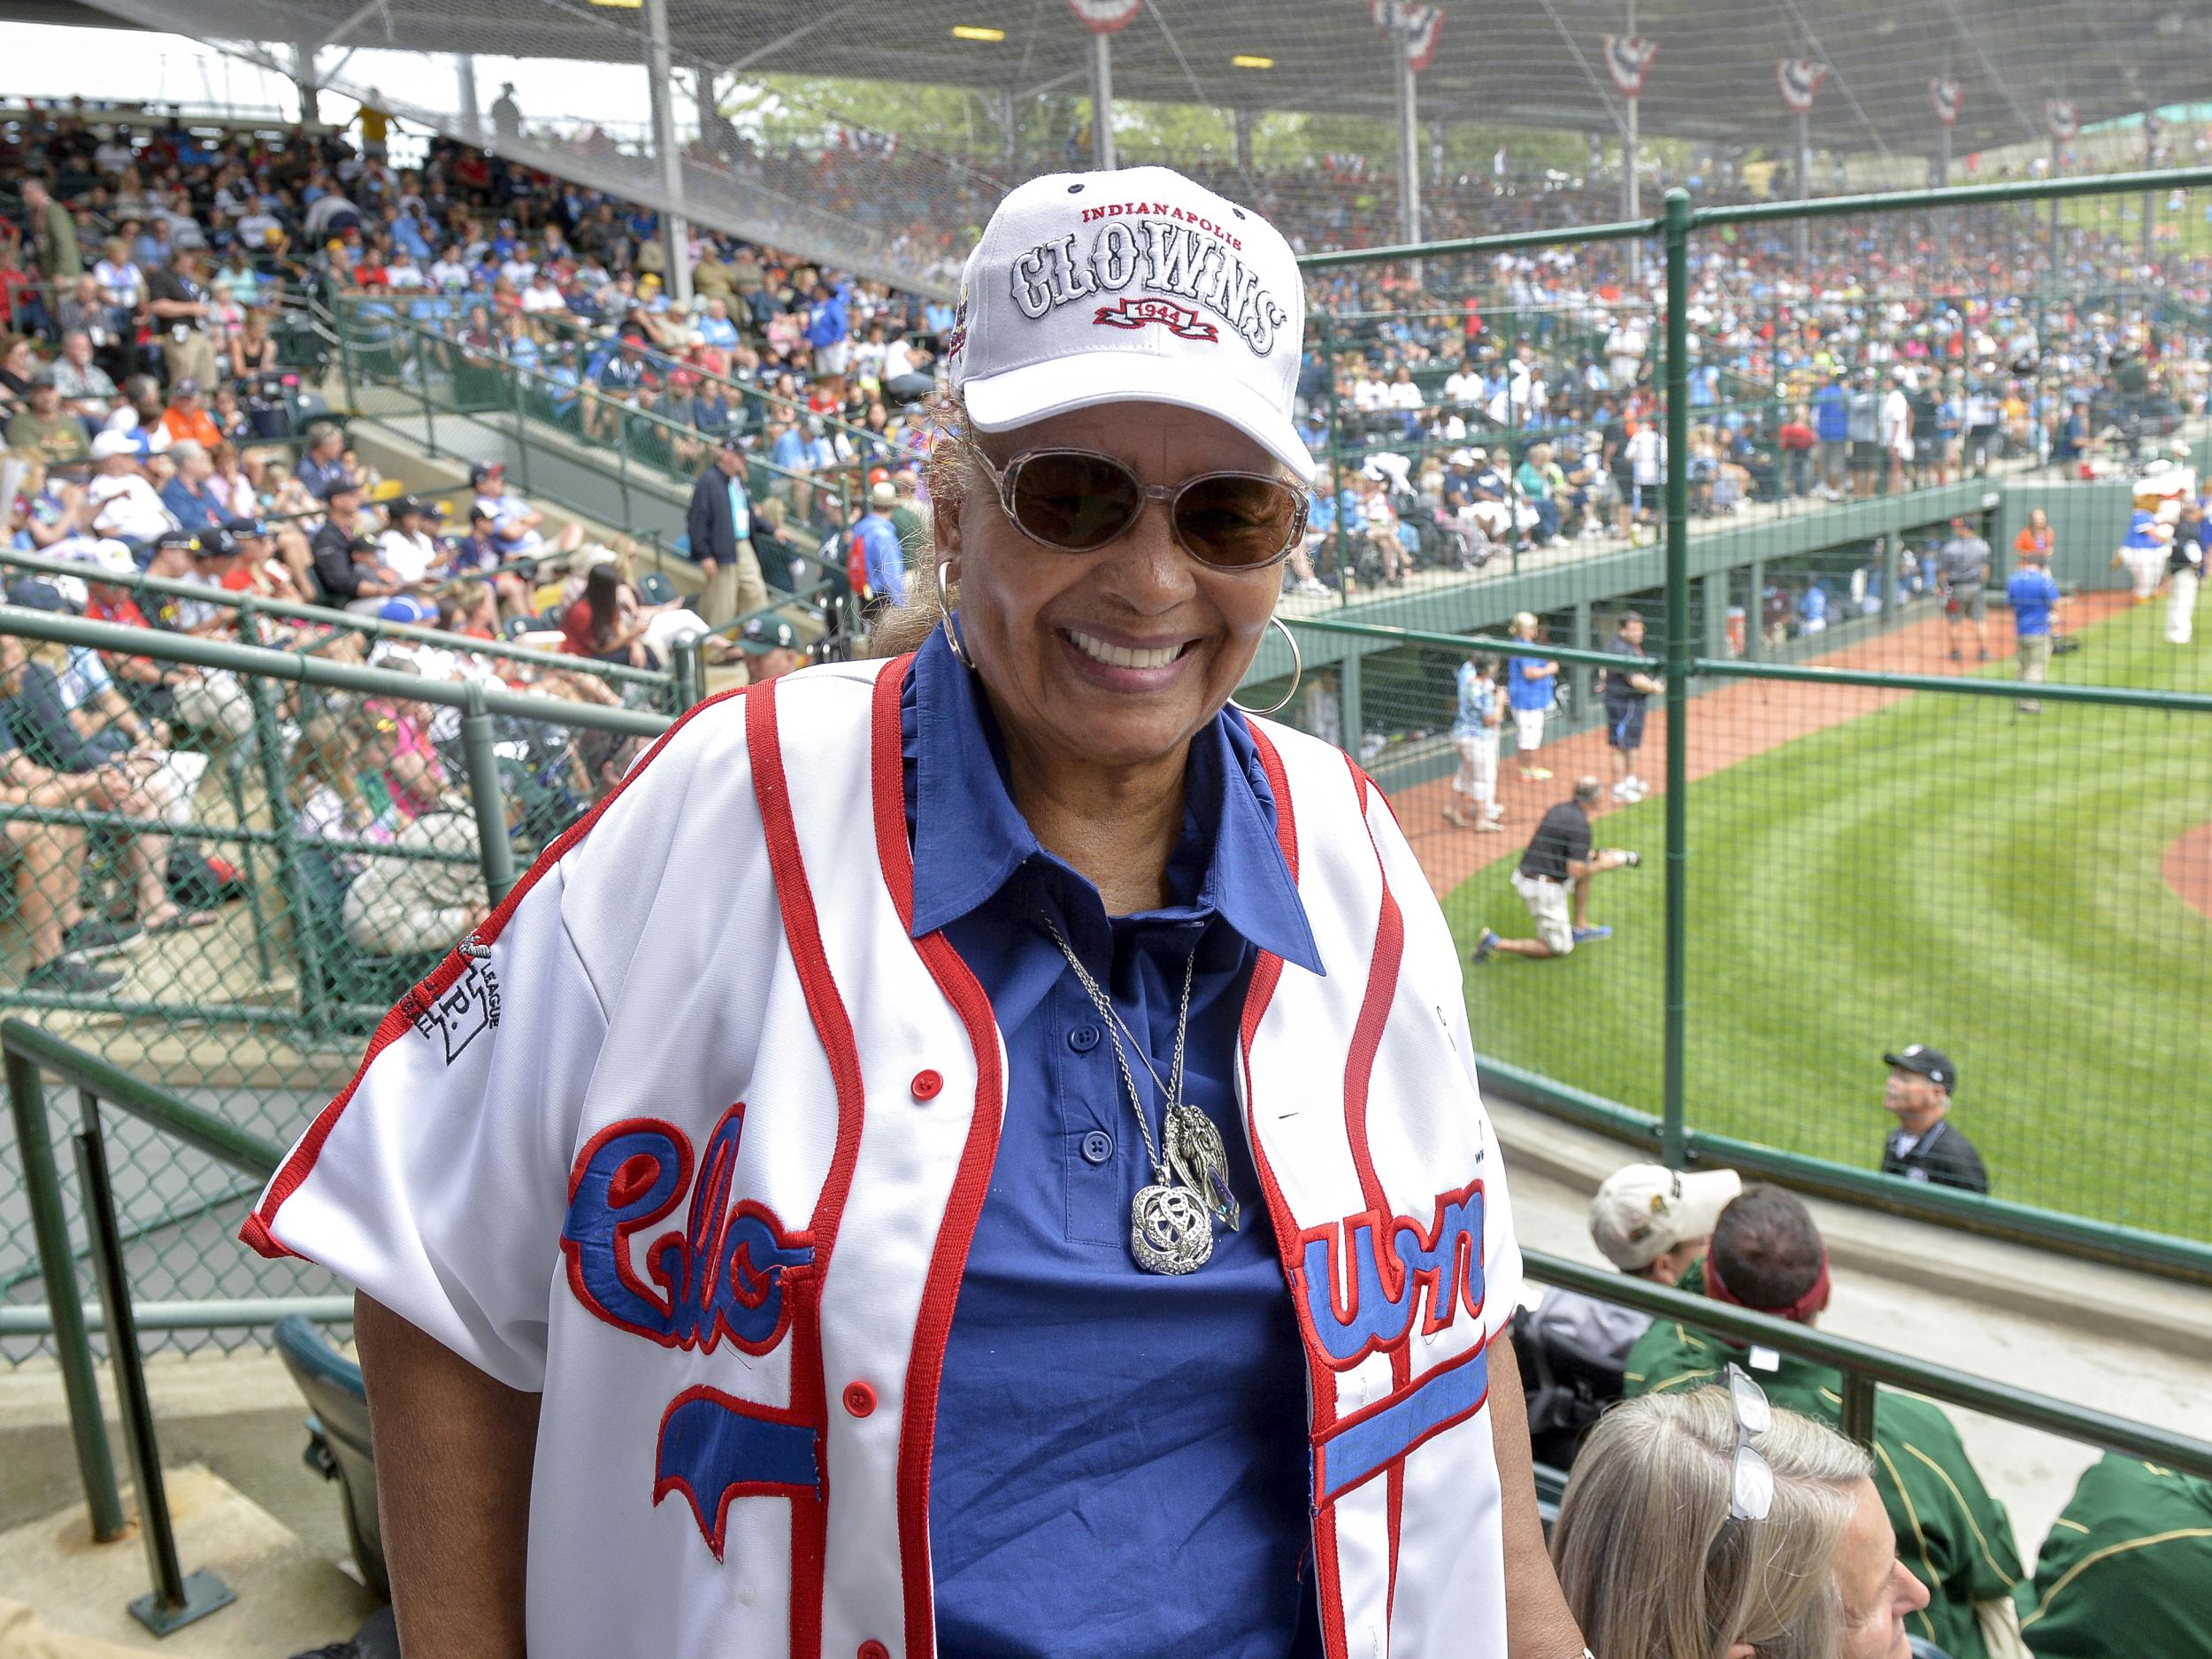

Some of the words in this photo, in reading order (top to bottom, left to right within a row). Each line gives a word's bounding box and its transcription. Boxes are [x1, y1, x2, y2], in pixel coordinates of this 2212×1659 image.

[1082, 202, 1242, 251] INDIANAPOLIS
[1010, 219, 1286, 357] CLOWNS
[1136, 303, 1180, 325] 1944
[480, 962, 501, 1030] LEAGUE
